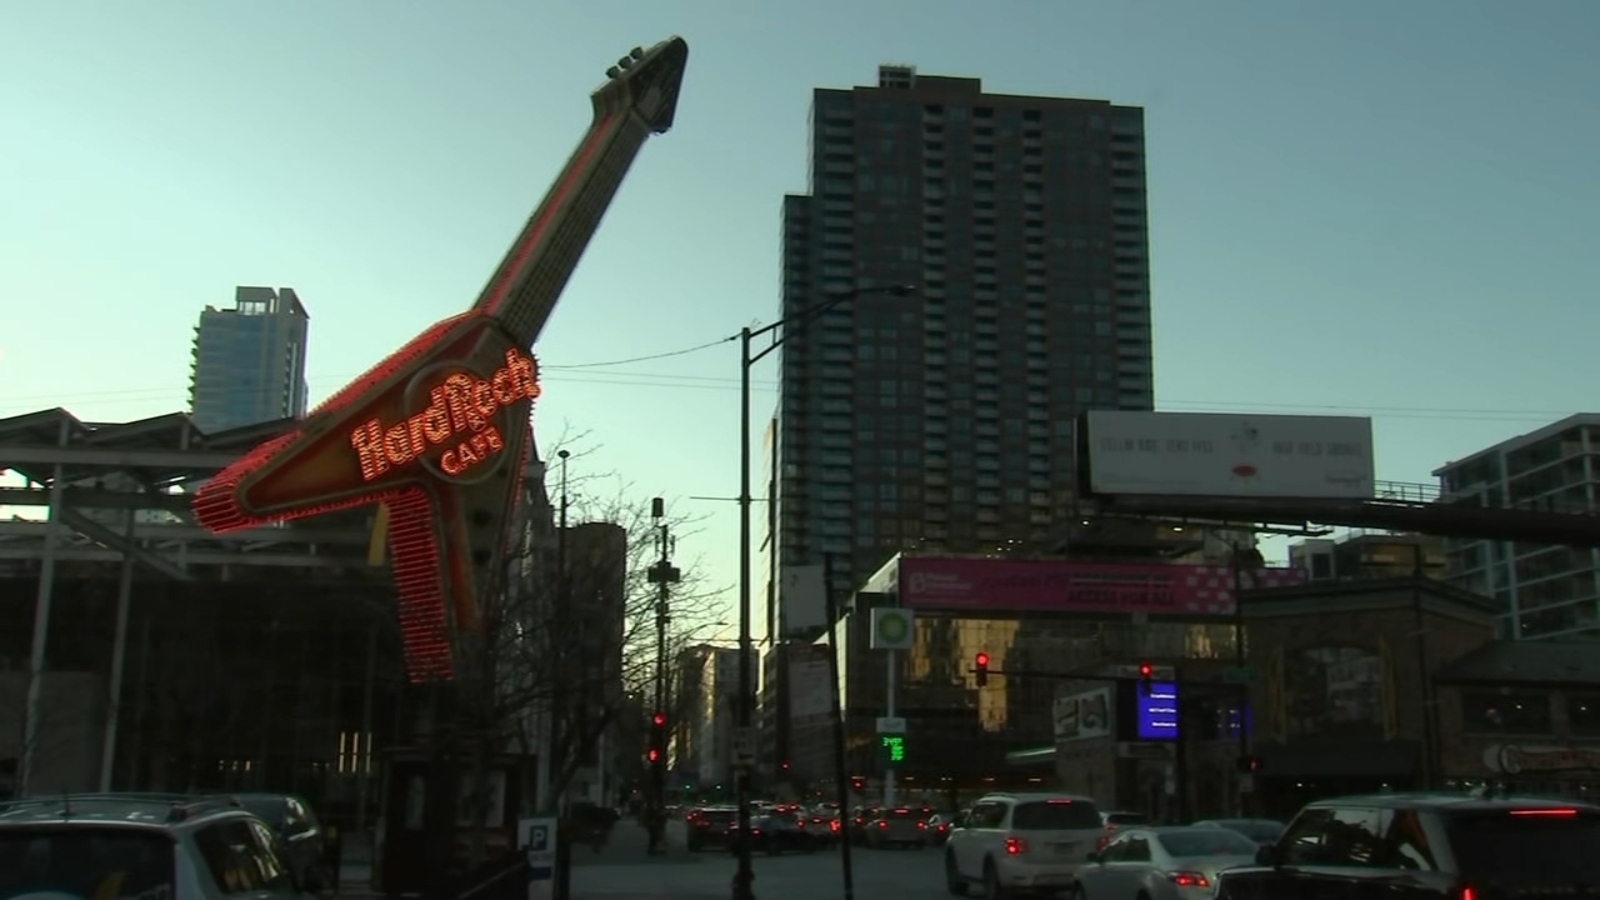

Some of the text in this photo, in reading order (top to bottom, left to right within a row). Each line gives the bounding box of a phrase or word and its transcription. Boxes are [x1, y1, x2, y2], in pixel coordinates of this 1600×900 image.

[351, 348, 541, 481] Hard Rock
[440, 427, 503, 475] CAFE
[533, 829, 546, 848] P
